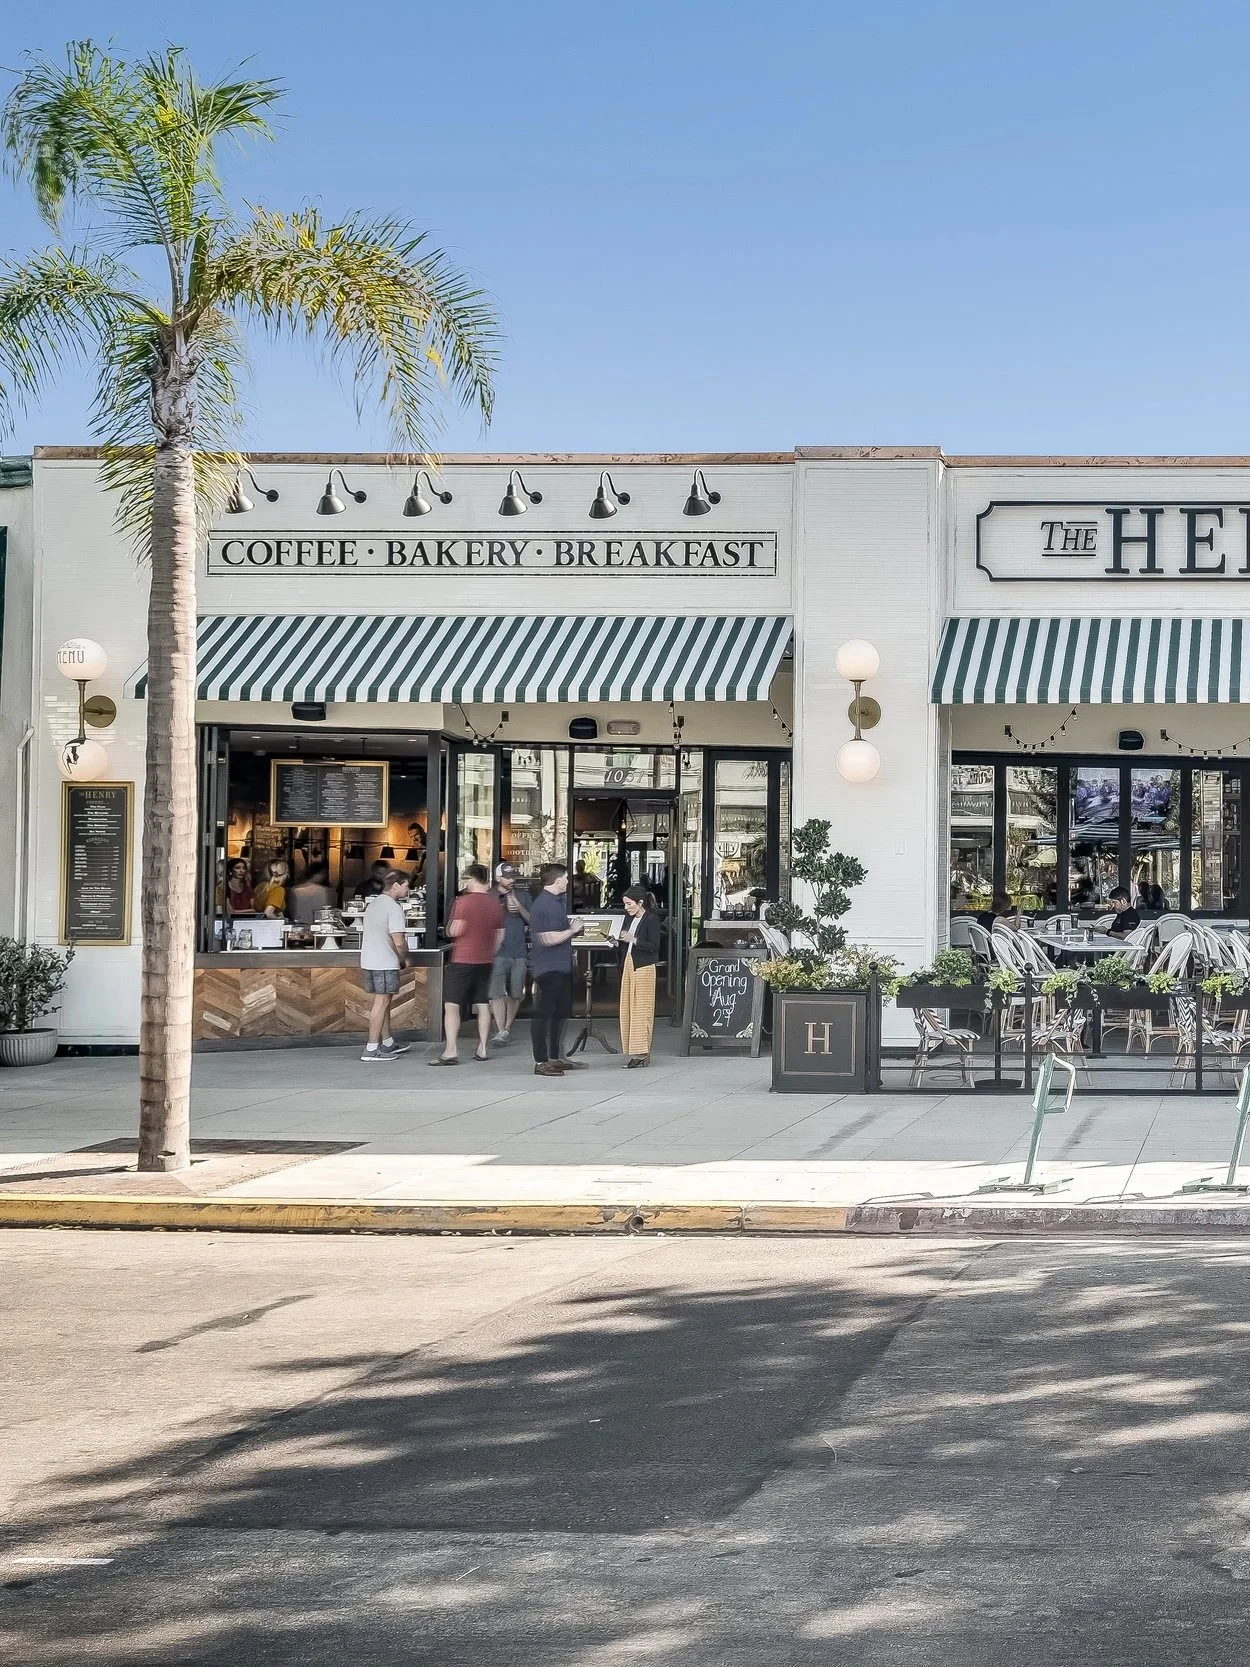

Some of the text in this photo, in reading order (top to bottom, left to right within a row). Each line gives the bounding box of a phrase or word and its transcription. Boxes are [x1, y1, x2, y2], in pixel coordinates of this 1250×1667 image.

[221, 540, 764, 567] COFFEE BAKERY BREAKFAST
[56, 650, 85, 664] MENU
[85, 791, 117, 799] HENRY
[709, 958, 741, 974] Grand
[701, 970, 748, 996] Opening
[712, 1008, 732, 1028] 27
[804, 1022, 833, 1055] H
